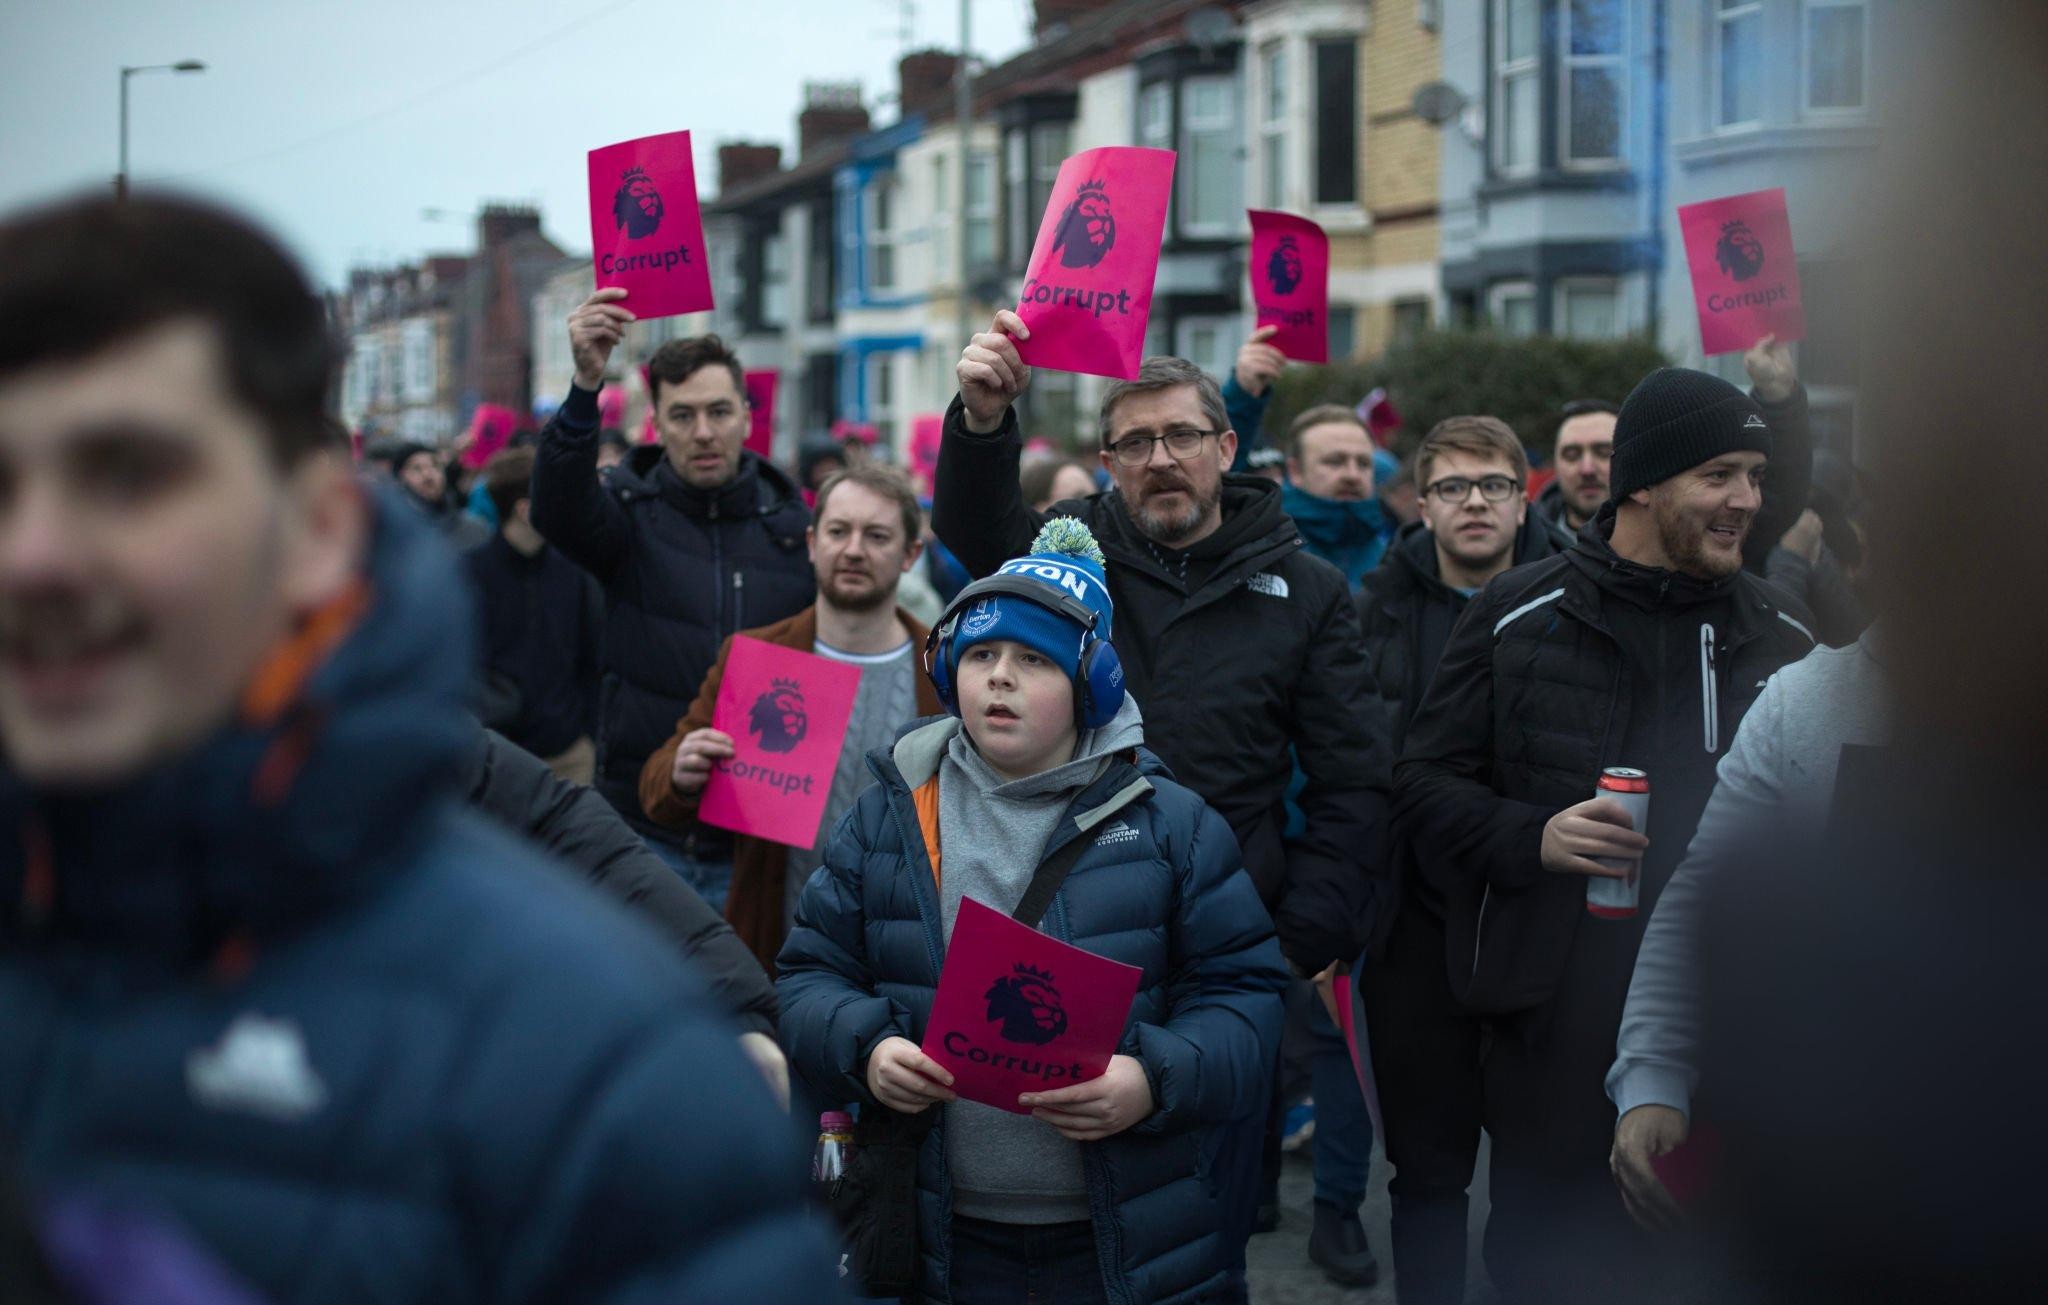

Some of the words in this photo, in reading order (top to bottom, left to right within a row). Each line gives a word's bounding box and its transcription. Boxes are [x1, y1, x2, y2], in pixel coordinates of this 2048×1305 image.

[601, 246, 692, 275] Corrupt
[1021, 278, 1131, 318] Corrupt
[1707, 284, 1787, 313] Corrupt
[943, 1031, 1082, 1080] Corrupt
